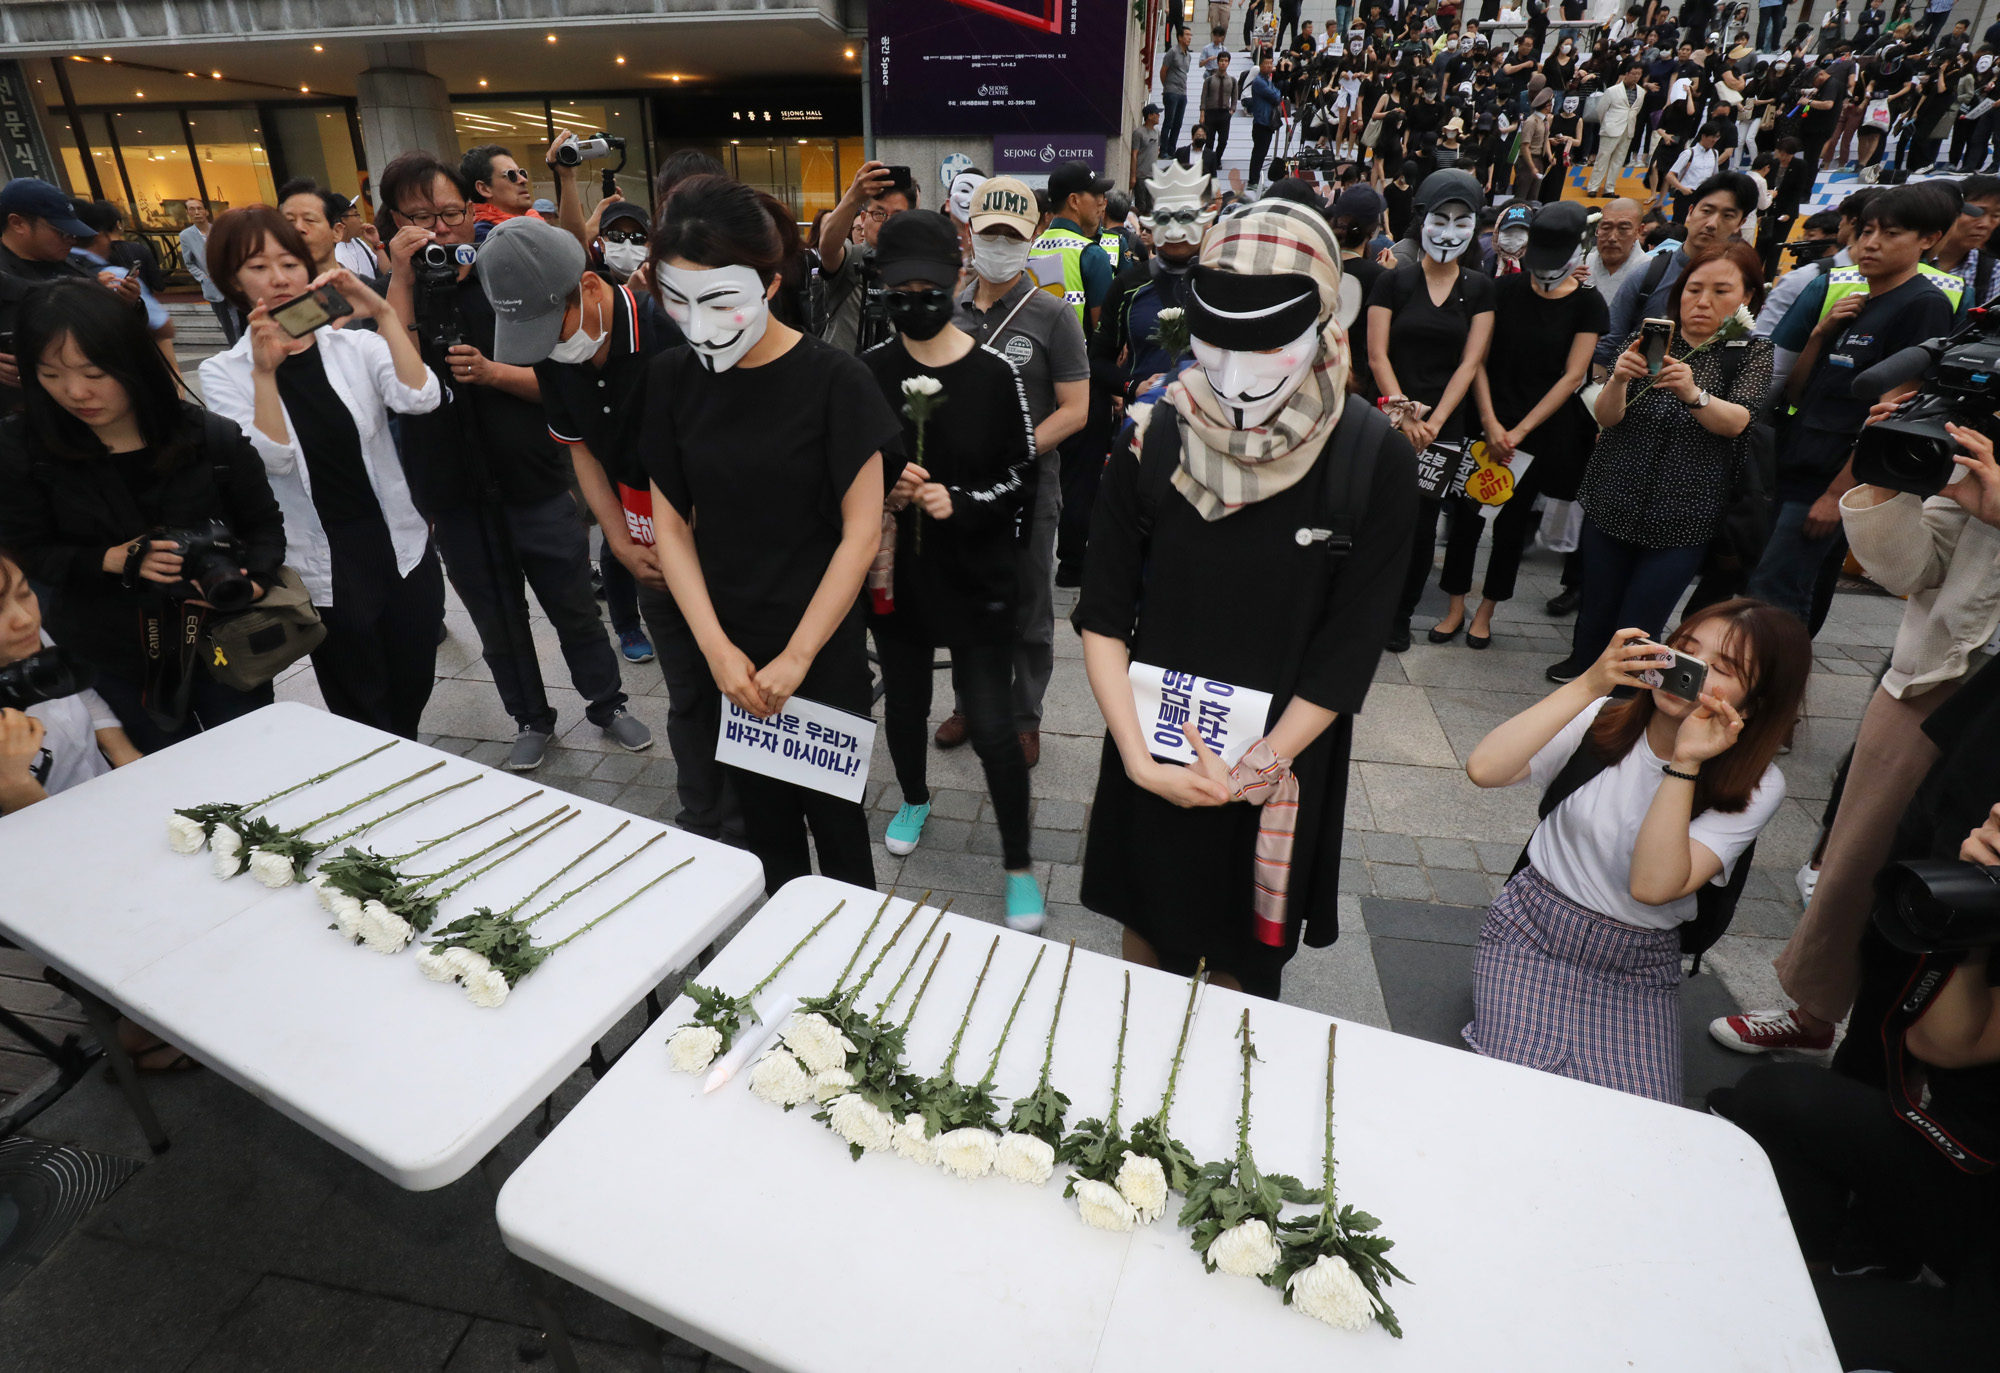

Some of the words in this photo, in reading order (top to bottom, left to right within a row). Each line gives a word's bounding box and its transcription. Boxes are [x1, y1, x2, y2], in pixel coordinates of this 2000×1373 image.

[880, 57, 890, 86] Space
[0, 75, 39, 180] 전문식
[780, 110, 804, 118] SEJONG
[1003, 149, 1037, 159] SEJONG
[1058, 149, 1094, 158] CENTER
[982, 190, 1029, 216] JUMP
[1508, 208, 1525, 219] M
[1477, 468, 1495, 487] 39
[147, 618, 160, 659] Canon
[186, 615, 198, 644] EOS
[726, 720, 779, 754] 바꾸자
[783, 738, 861, 777] 아시아나!
[805, 721, 858, 753] 우리가
[1903, 970, 1942, 1012] Canon
[1906, 1111, 1966, 1160] Canon
